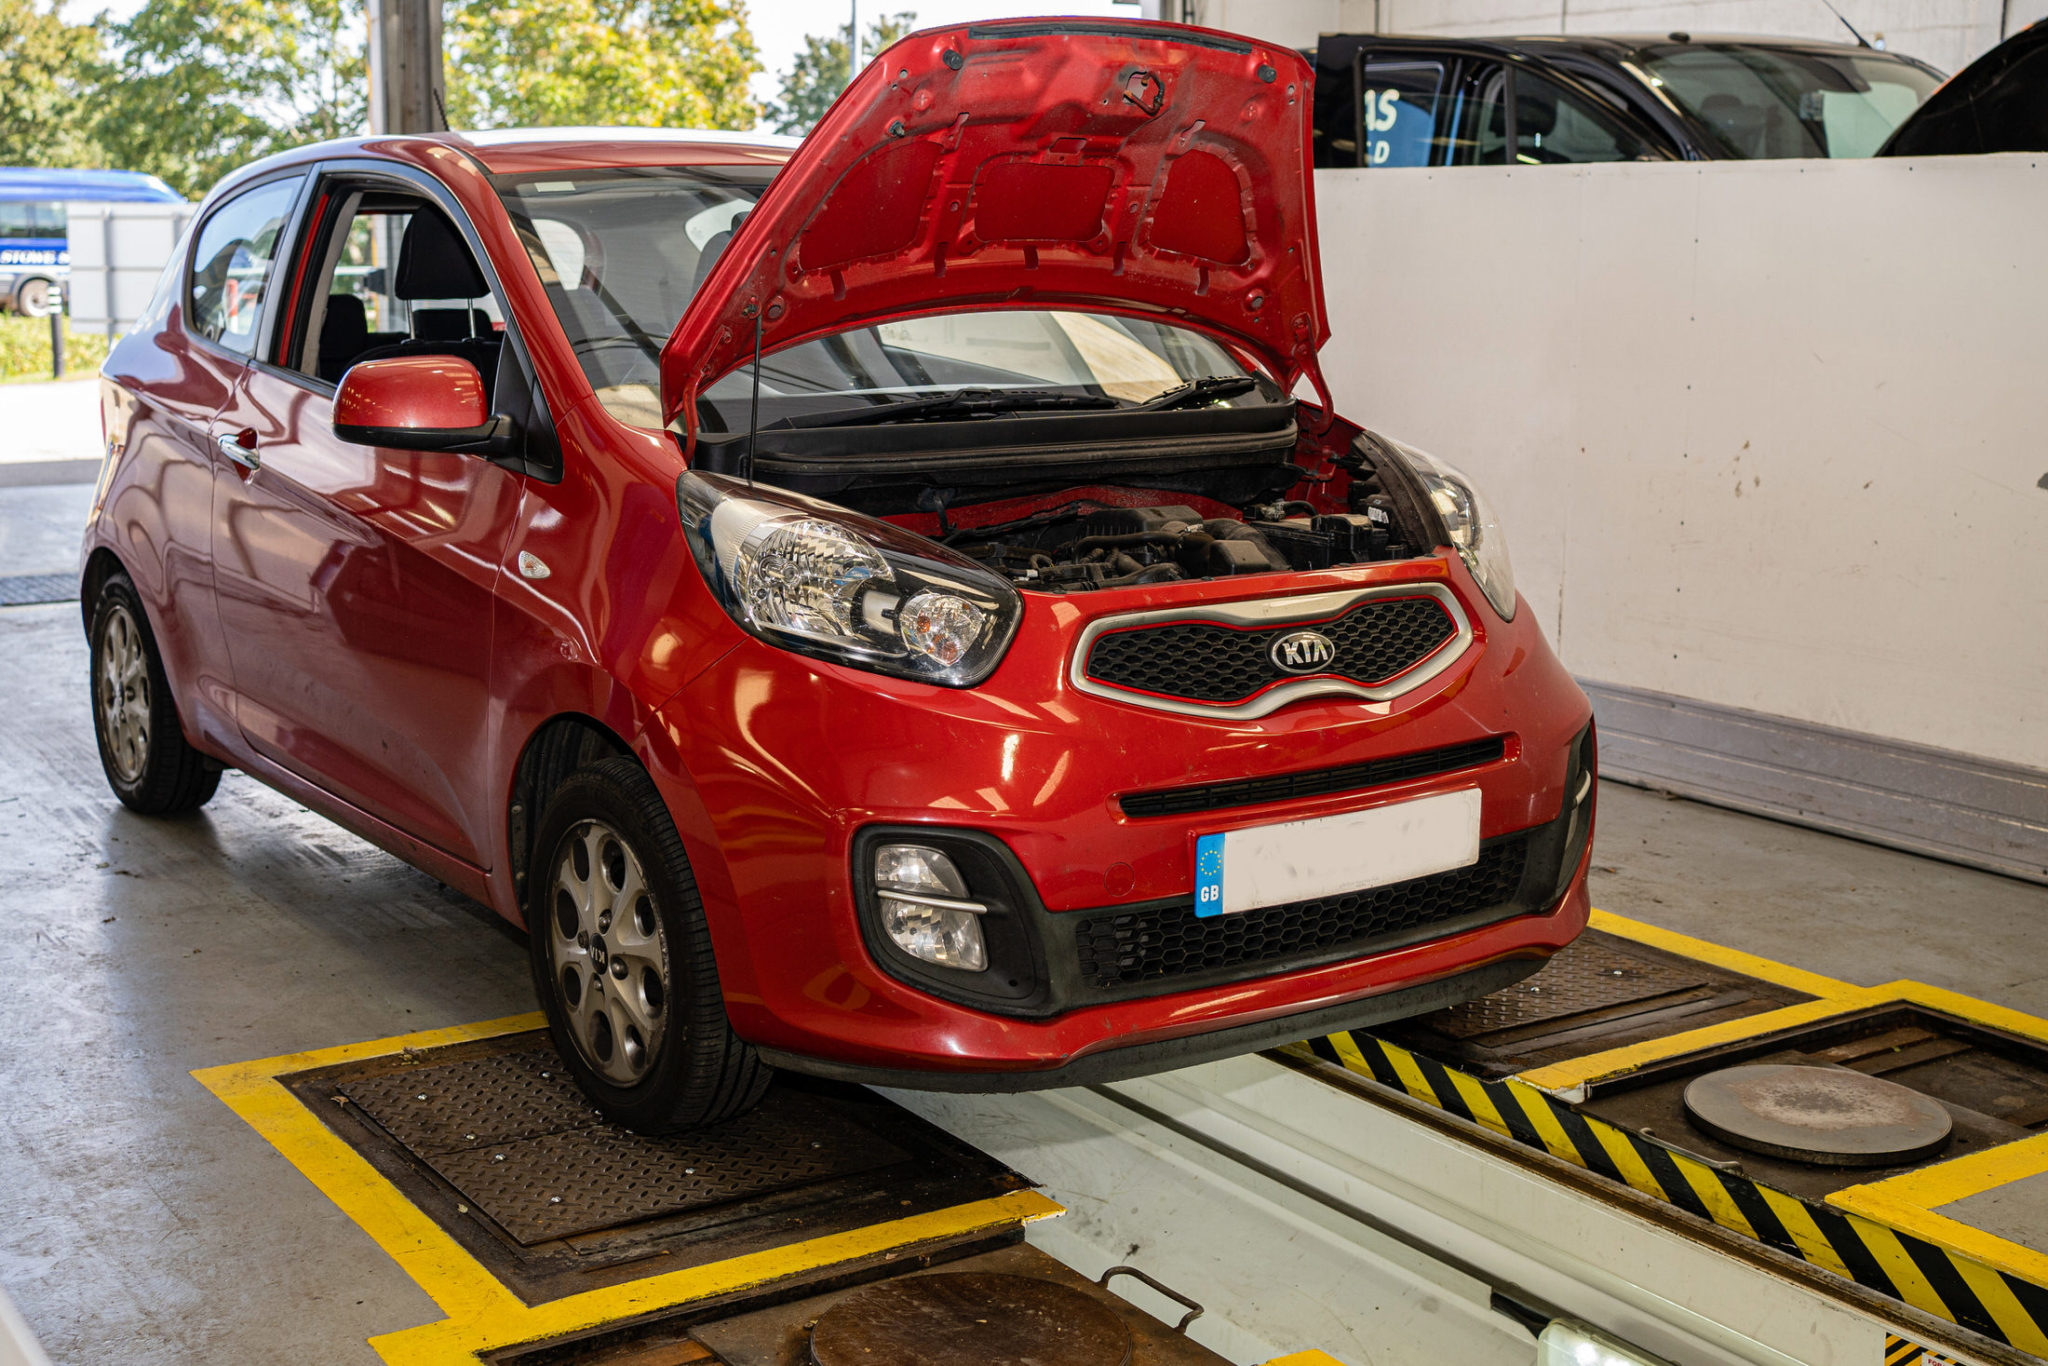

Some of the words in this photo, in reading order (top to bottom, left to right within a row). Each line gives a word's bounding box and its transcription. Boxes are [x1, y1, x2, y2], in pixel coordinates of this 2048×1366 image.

[1282, 639, 1328, 665] KIA
[1200, 885, 1219, 902] GB
[590, 945, 605, 964] KIA
